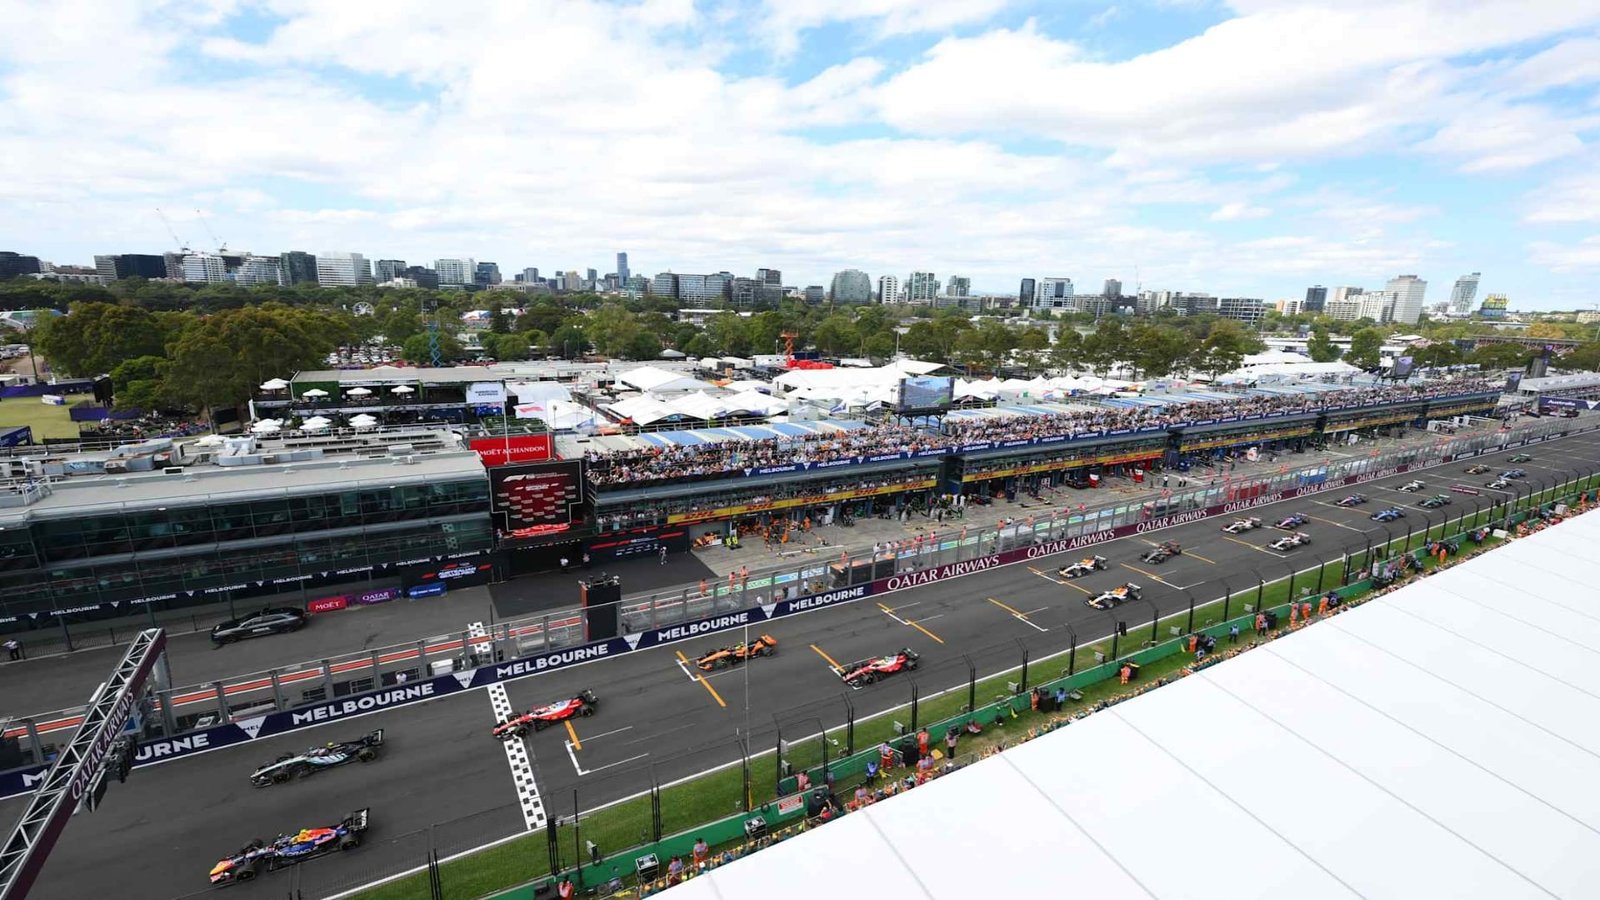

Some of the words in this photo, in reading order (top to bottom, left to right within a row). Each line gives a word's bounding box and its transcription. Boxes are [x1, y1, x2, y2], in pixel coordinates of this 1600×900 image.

[509, 445, 545, 454] CHANDON
[870, 454, 900, 462] MELBOURNE
[817, 459, 850, 468] MELBOURNE
[759, 465, 796, 474] MELBOURNE
[1296, 485, 1319, 496] QATAR
[1320, 479, 1346, 492] AIRWAYS
[1224, 500, 1251, 513] QATAR
[1252, 492, 1282, 508] AIRWAYS
[1136, 518, 1168, 533] QATAR
[1171, 508, 1208, 526] AIRWAYS
[1026, 540, 1067, 558] QATAR
[1069, 528, 1115, 548] AIRWAYS
[448, 551, 480, 559] MELBOURNE
[396, 558, 430, 566] MELBOURNE
[336, 566, 373, 574] MELBOURNE
[887, 568, 939, 591] QATAR
[942, 554, 1000, 578] AIRWAYS
[273, 574, 312, 584] MELBOURNE
[204, 584, 247, 593] MELBOURNE
[131, 594, 176, 604] MELBOURNE
[362, 592, 389, 600] QATAR
[789, 586, 865, 612] MELBOURNE
[50, 605, 100, 615] MELBOURNE
[315, 601, 340, 610] MOËT
[658, 612, 749, 642] MELBOURNE
[496, 644, 608, 678] MELBOURNE
[292, 682, 434, 725] MELBOURNE
[72, 742, 104, 800] QATAR
[102, 687, 134, 752] AIRWAYS
